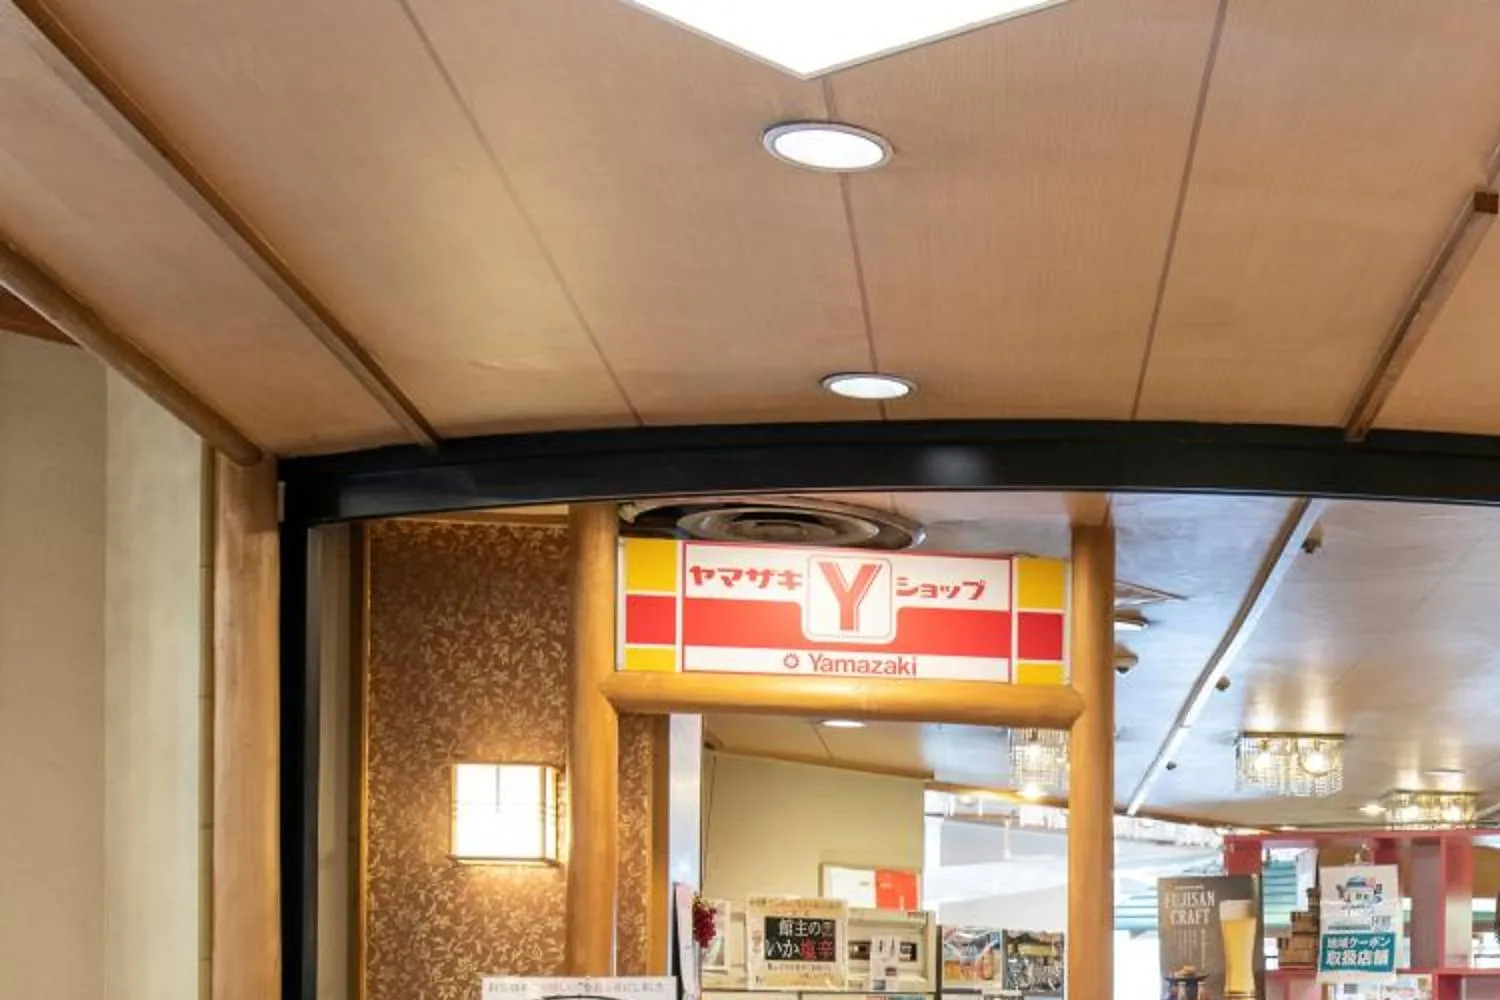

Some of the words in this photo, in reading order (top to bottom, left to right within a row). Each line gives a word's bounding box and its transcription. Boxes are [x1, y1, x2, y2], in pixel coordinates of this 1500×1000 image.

[688, 565, 803, 590] ヤマザキ
[896, 577, 987, 601] ショップ
[808, 653, 918, 677] Yamazaki
[1171, 907, 1211, 925] CRAFT
